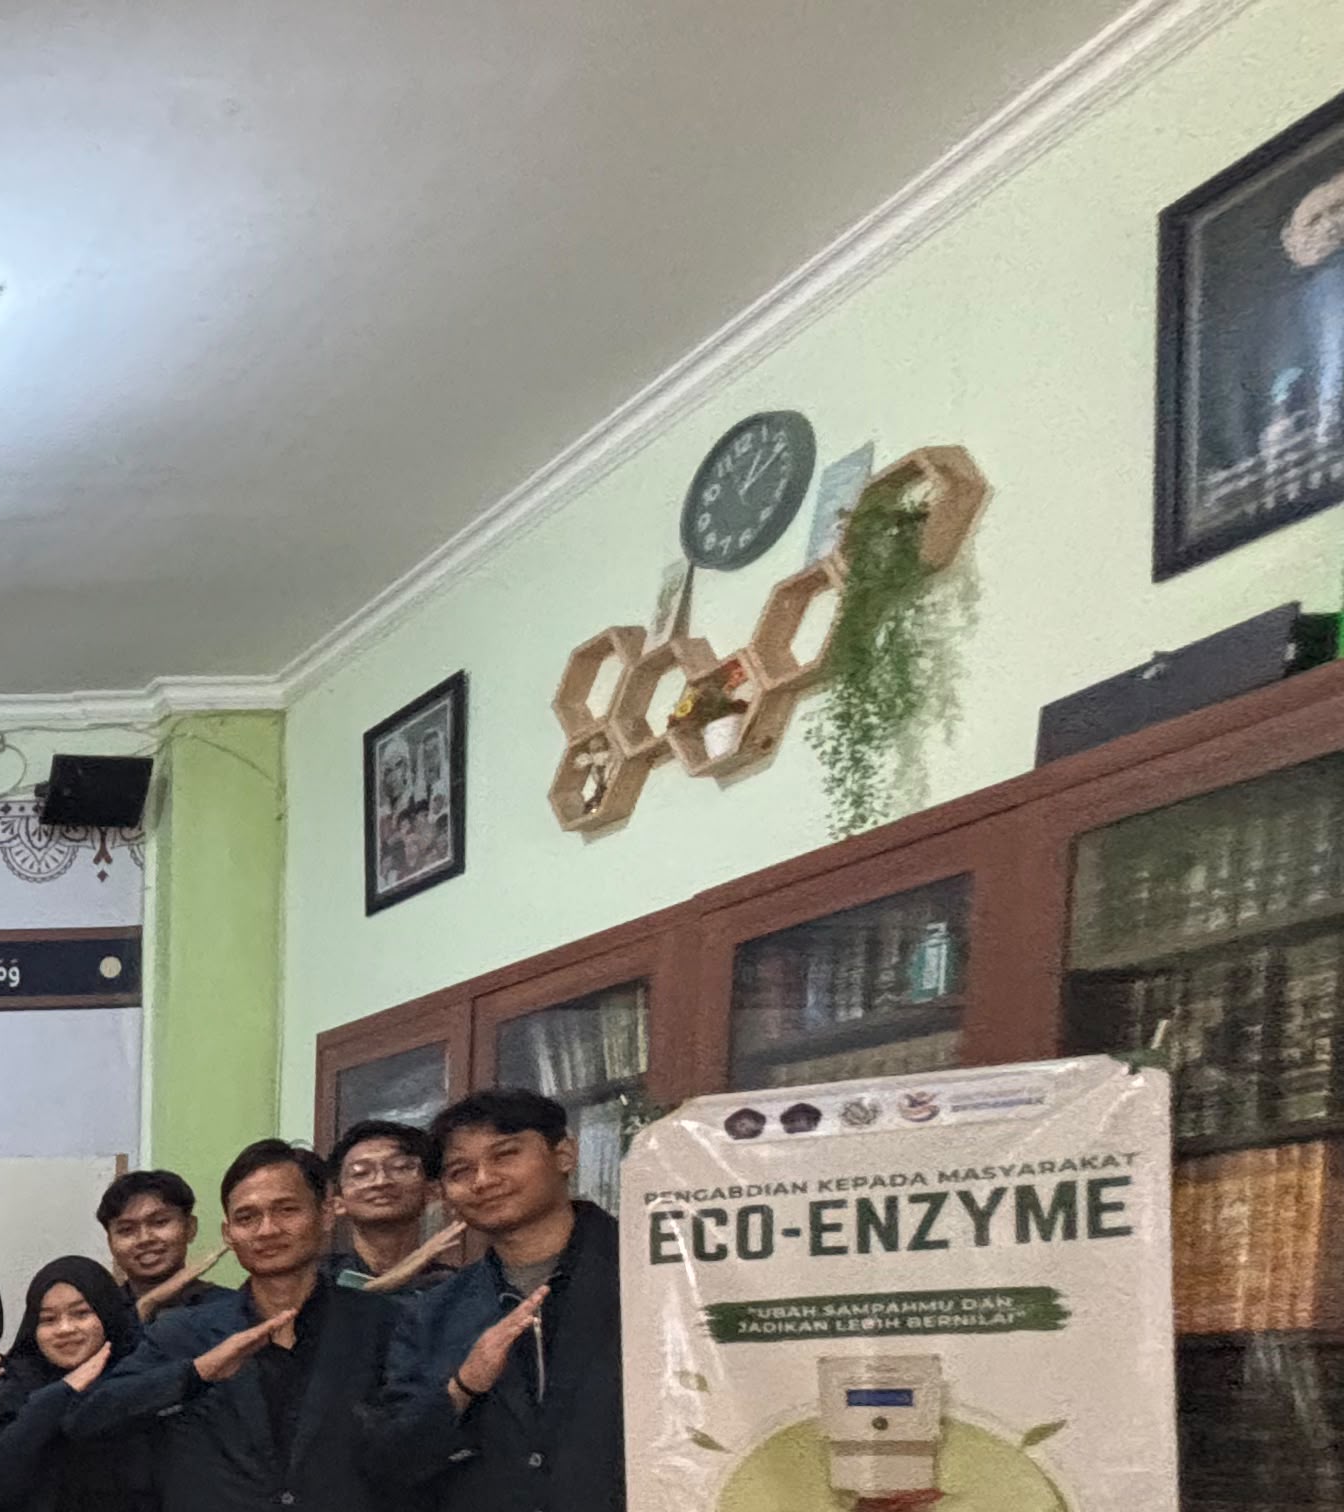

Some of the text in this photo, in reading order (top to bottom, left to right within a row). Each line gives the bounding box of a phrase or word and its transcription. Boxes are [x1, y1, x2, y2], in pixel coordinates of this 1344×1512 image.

[644, 1150, 1140, 1206] PENGABDIAN KEPADA MASYARAKAT
[649, 1175, 1134, 1266] ECO-ENZYME
[823, 1300, 955, 1317] SAMPAHMU
[962, 1296, 1013, 1311] DAN
[738, 1321, 828, 1334] JADIKAN
